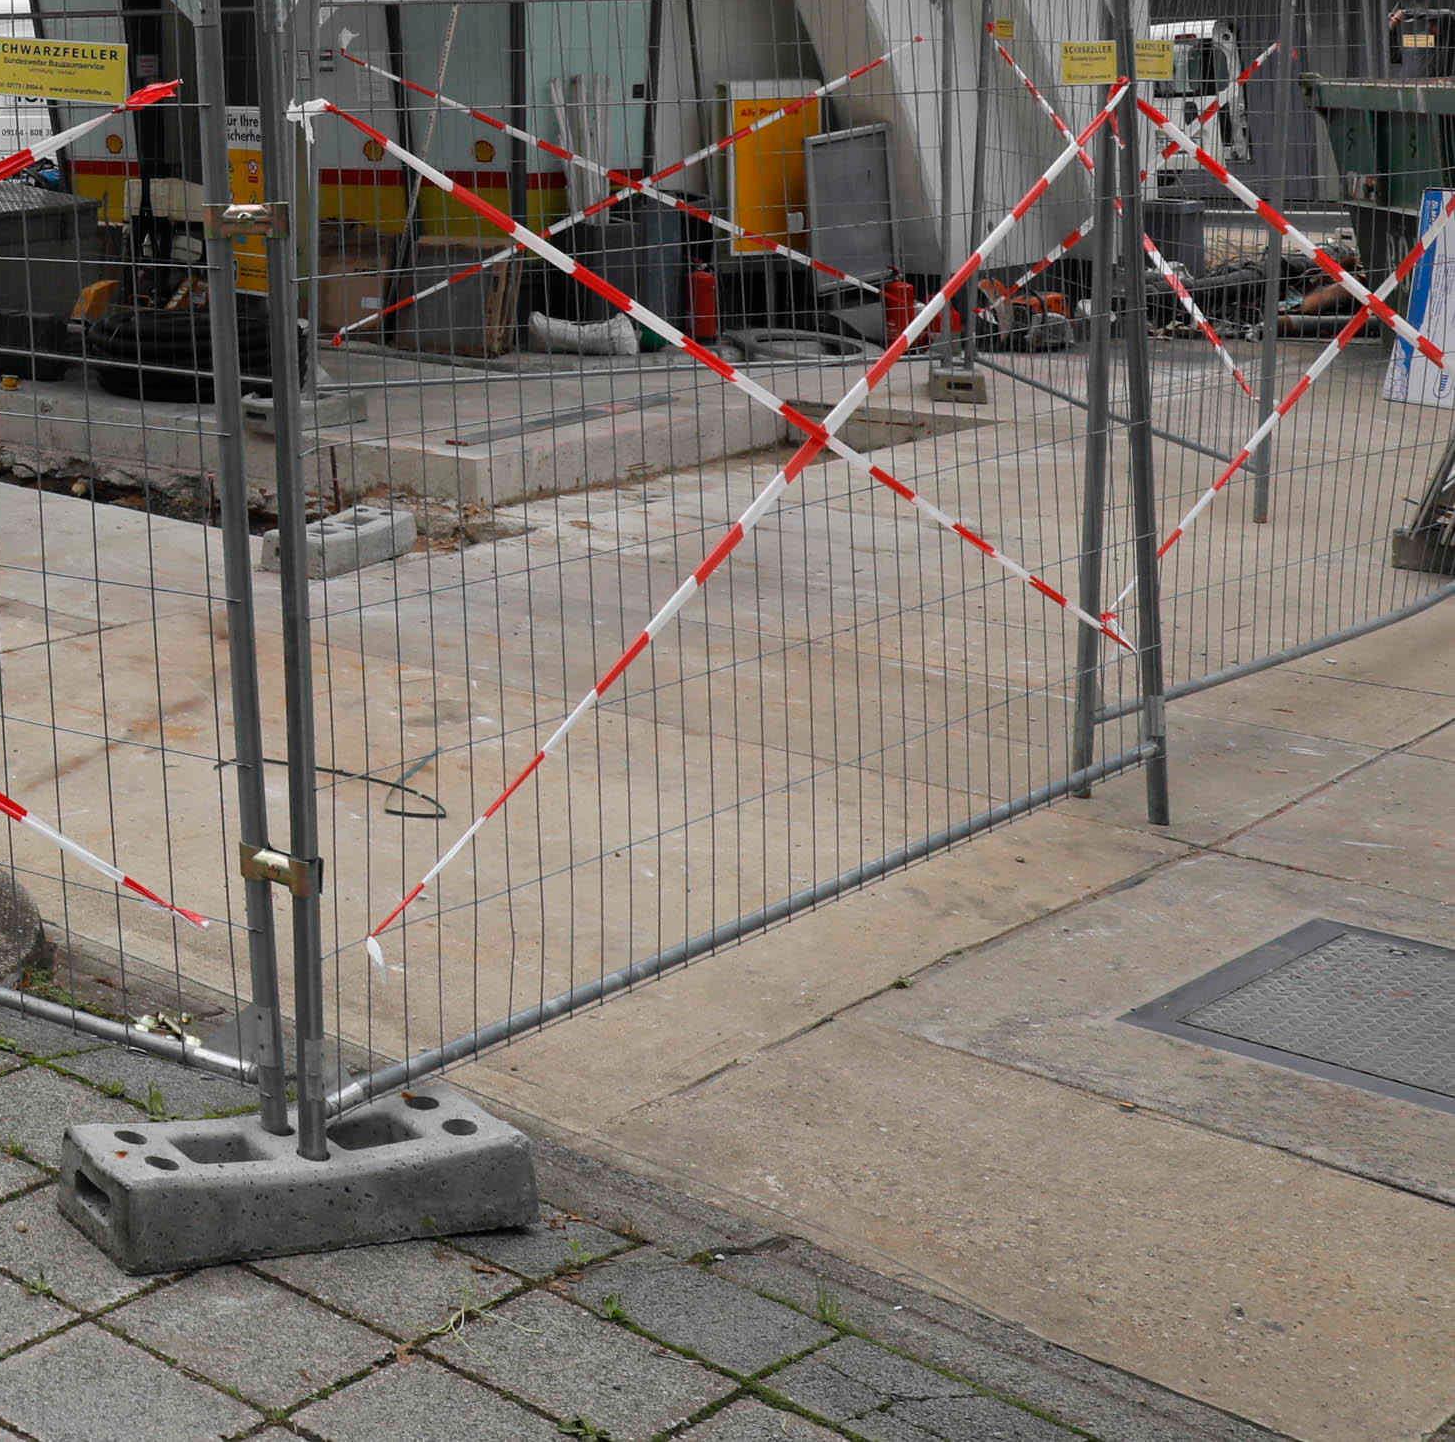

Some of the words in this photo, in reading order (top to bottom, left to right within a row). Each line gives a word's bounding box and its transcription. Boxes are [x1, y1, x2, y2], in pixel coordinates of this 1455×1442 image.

[226, 114, 236, 127] ür
[240, 114, 259, 128] Ihre
[226, 128, 263, 143] icherhe
